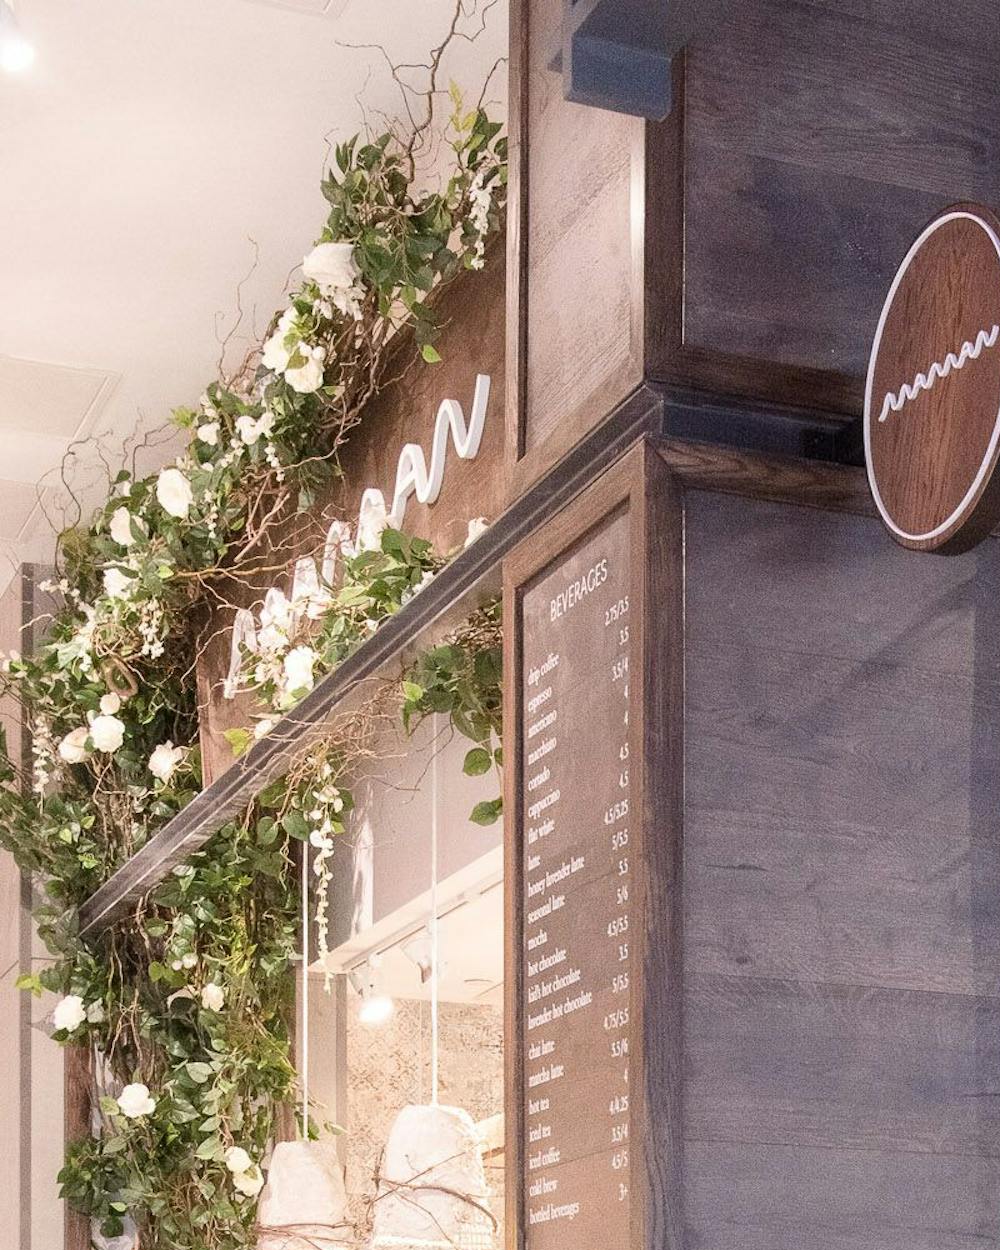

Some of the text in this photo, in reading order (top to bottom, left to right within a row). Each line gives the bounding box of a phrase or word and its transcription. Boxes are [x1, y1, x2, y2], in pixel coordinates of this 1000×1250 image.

[550, 559, 608, 622] BEVERAGES
[528, 652, 560, 686] drip coffee
[528, 687, 552, 713] espresso
[528, 710, 557, 738] americano
[528, 737, 557, 765] macchiato
[528, 766, 551, 791] cortado
[528, 789, 561, 820] cappuccino
[528, 818, 554, 845] flat white
[528, 856, 541, 872] latte
[528, 856, 585, 898] honey lavender latte
[528, 894, 566, 924] seasonal latte
[528, 930, 548, 950] mocha
[528, 948, 566, 977] hot chocolate
[541, 982, 552, 998] hot
[552, 968, 581, 992] chocolate
[528, 990, 592, 1030] lavender hot chocolate
[528, 1039, 555, 1060] chai latte
[528, 1064, 564, 1088] matcha latte
[528, 1098, 550, 1114] hot tea
[529, 1124, 551, 1142] iced tea
[529, 1146, 560, 1170] iced coffee
[530, 1177, 558, 1196] cold brew
[618, 1183, 628, 1201] 3+
[530, 1202, 580, 1224] bottled beverages
